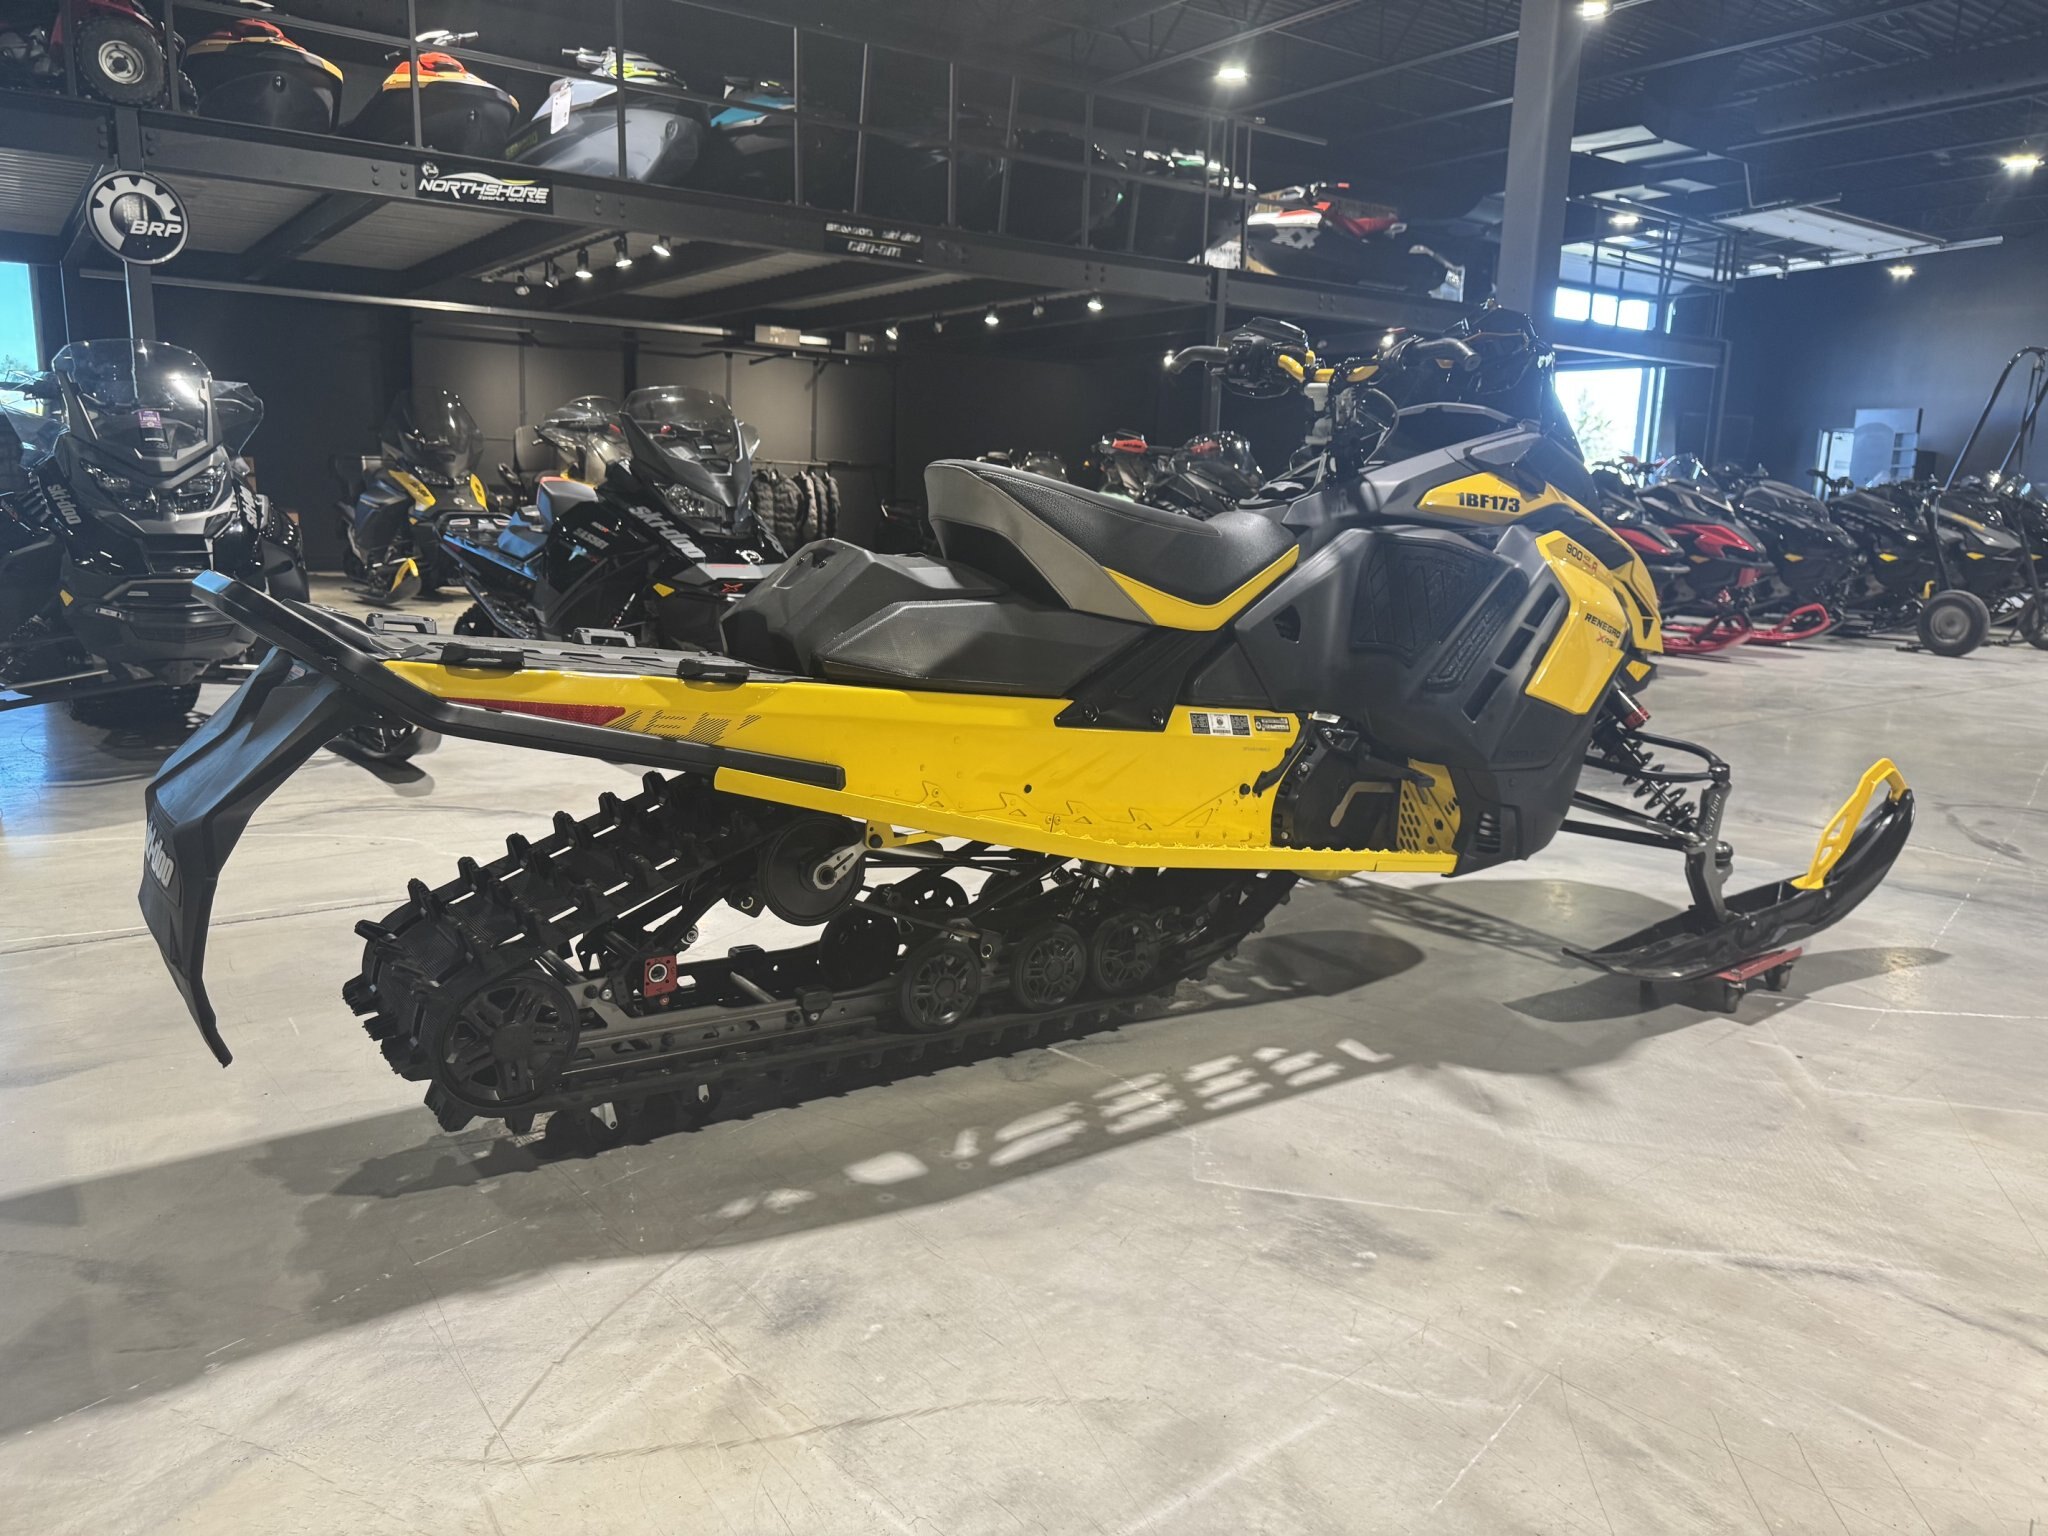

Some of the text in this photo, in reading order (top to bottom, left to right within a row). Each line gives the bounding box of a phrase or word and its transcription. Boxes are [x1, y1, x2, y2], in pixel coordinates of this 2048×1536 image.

[418, 178, 550, 200] NORTHSHORE
[129, 219, 182, 238] BRP
[47, 483, 82, 525] ski-doo
[1457, 492, 1520, 513] 1BF173
[628, 505, 707, 559] ski-doo
[1566, 543, 1583, 561] 900
